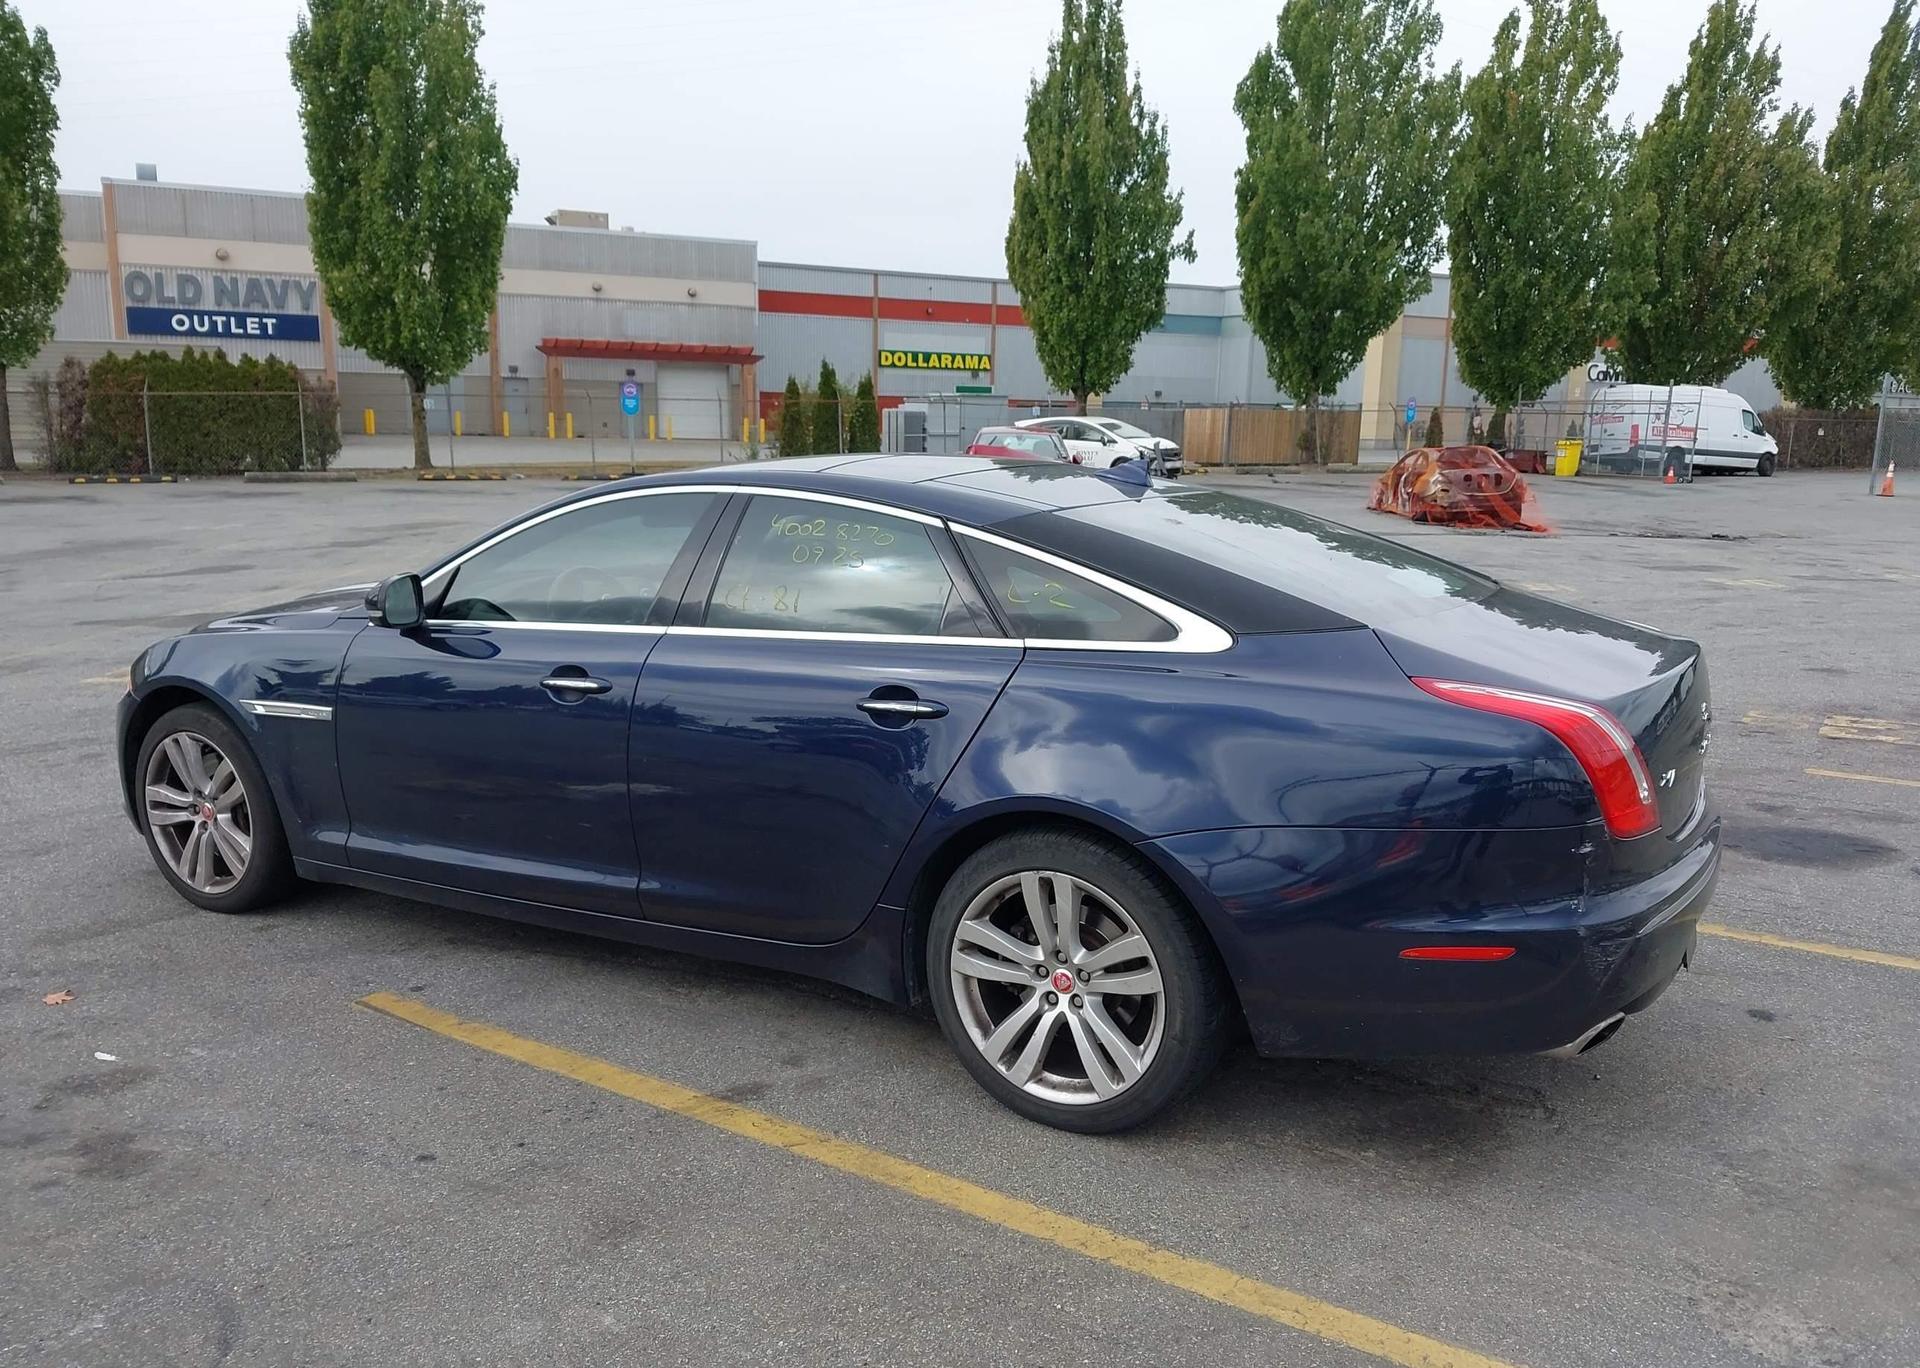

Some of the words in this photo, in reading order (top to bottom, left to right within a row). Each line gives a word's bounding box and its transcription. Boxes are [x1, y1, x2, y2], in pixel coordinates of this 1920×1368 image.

[124, 270, 203, 306] OLD
[212, 275, 317, 312] NAVY
[170, 313, 277, 336] OUTLET
[880, 351, 991, 369] DOLLARAMA
[771, 513, 827, 537] 4002
